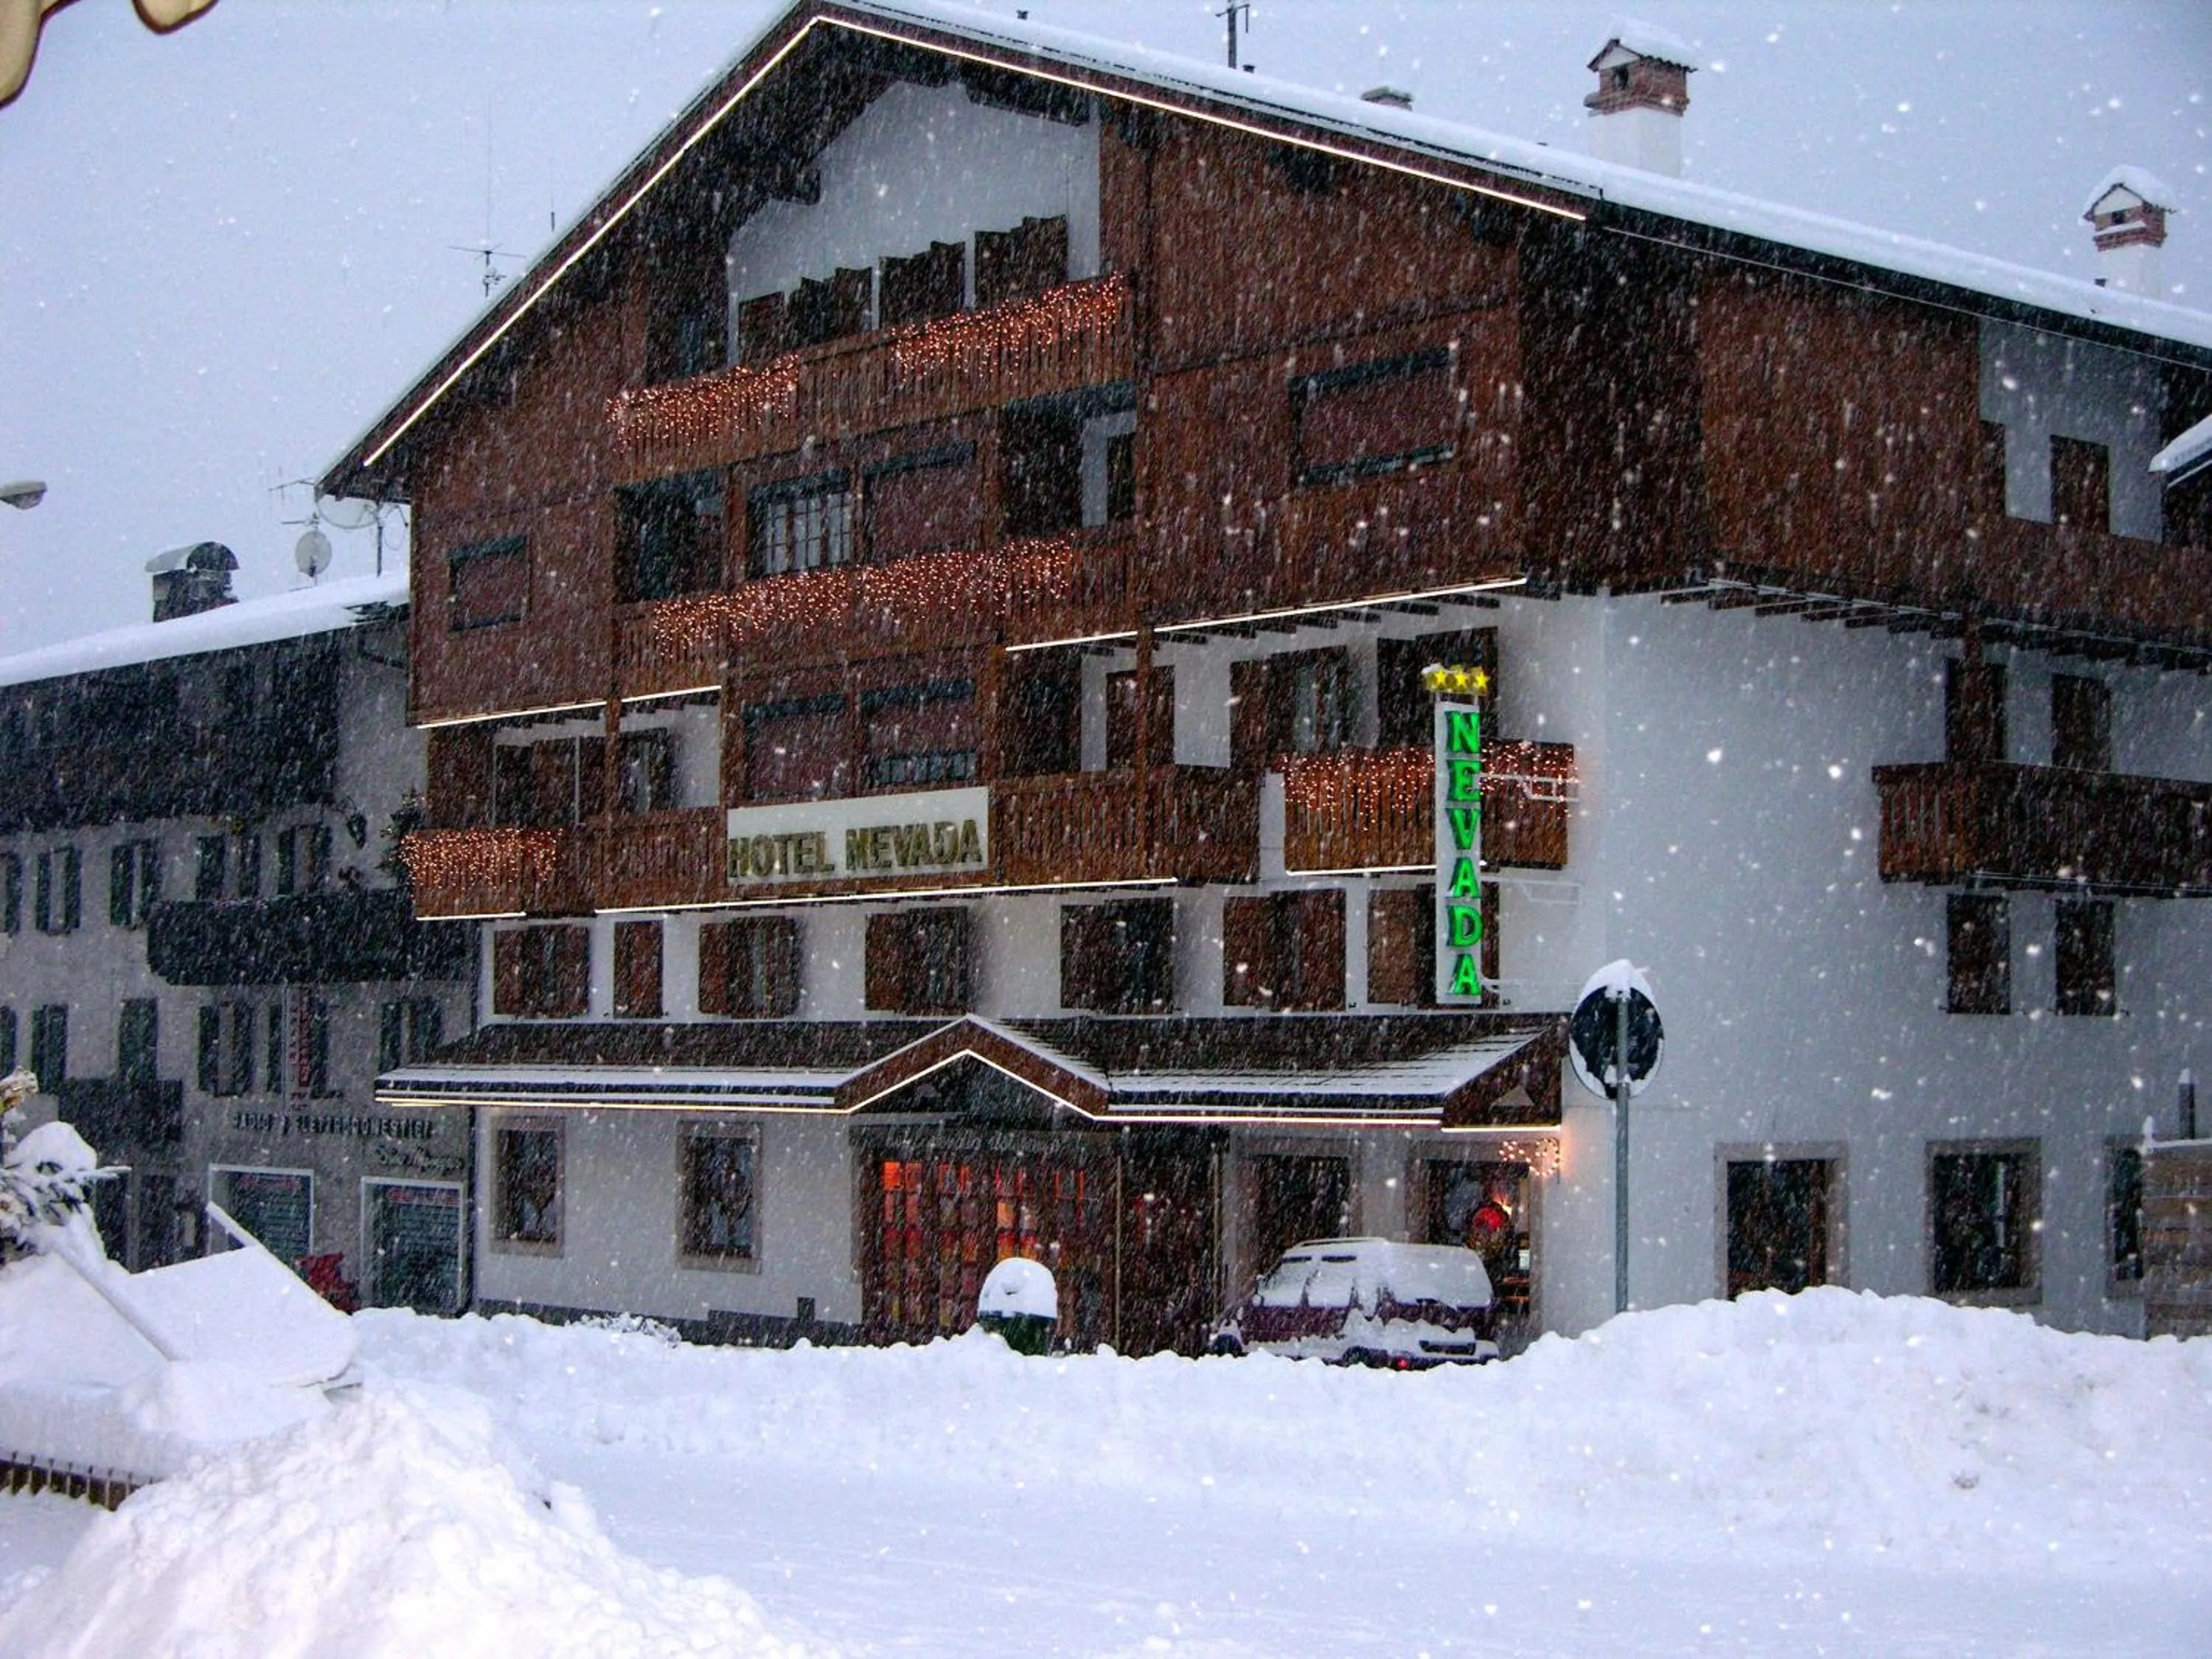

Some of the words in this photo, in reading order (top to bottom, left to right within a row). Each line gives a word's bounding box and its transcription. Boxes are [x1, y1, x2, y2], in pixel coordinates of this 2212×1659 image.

[728, 830, 835, 878] HOTEL
[845, 818, 983, 870] NEVADA
[1444, 710, 1484, 996] NEVADA
